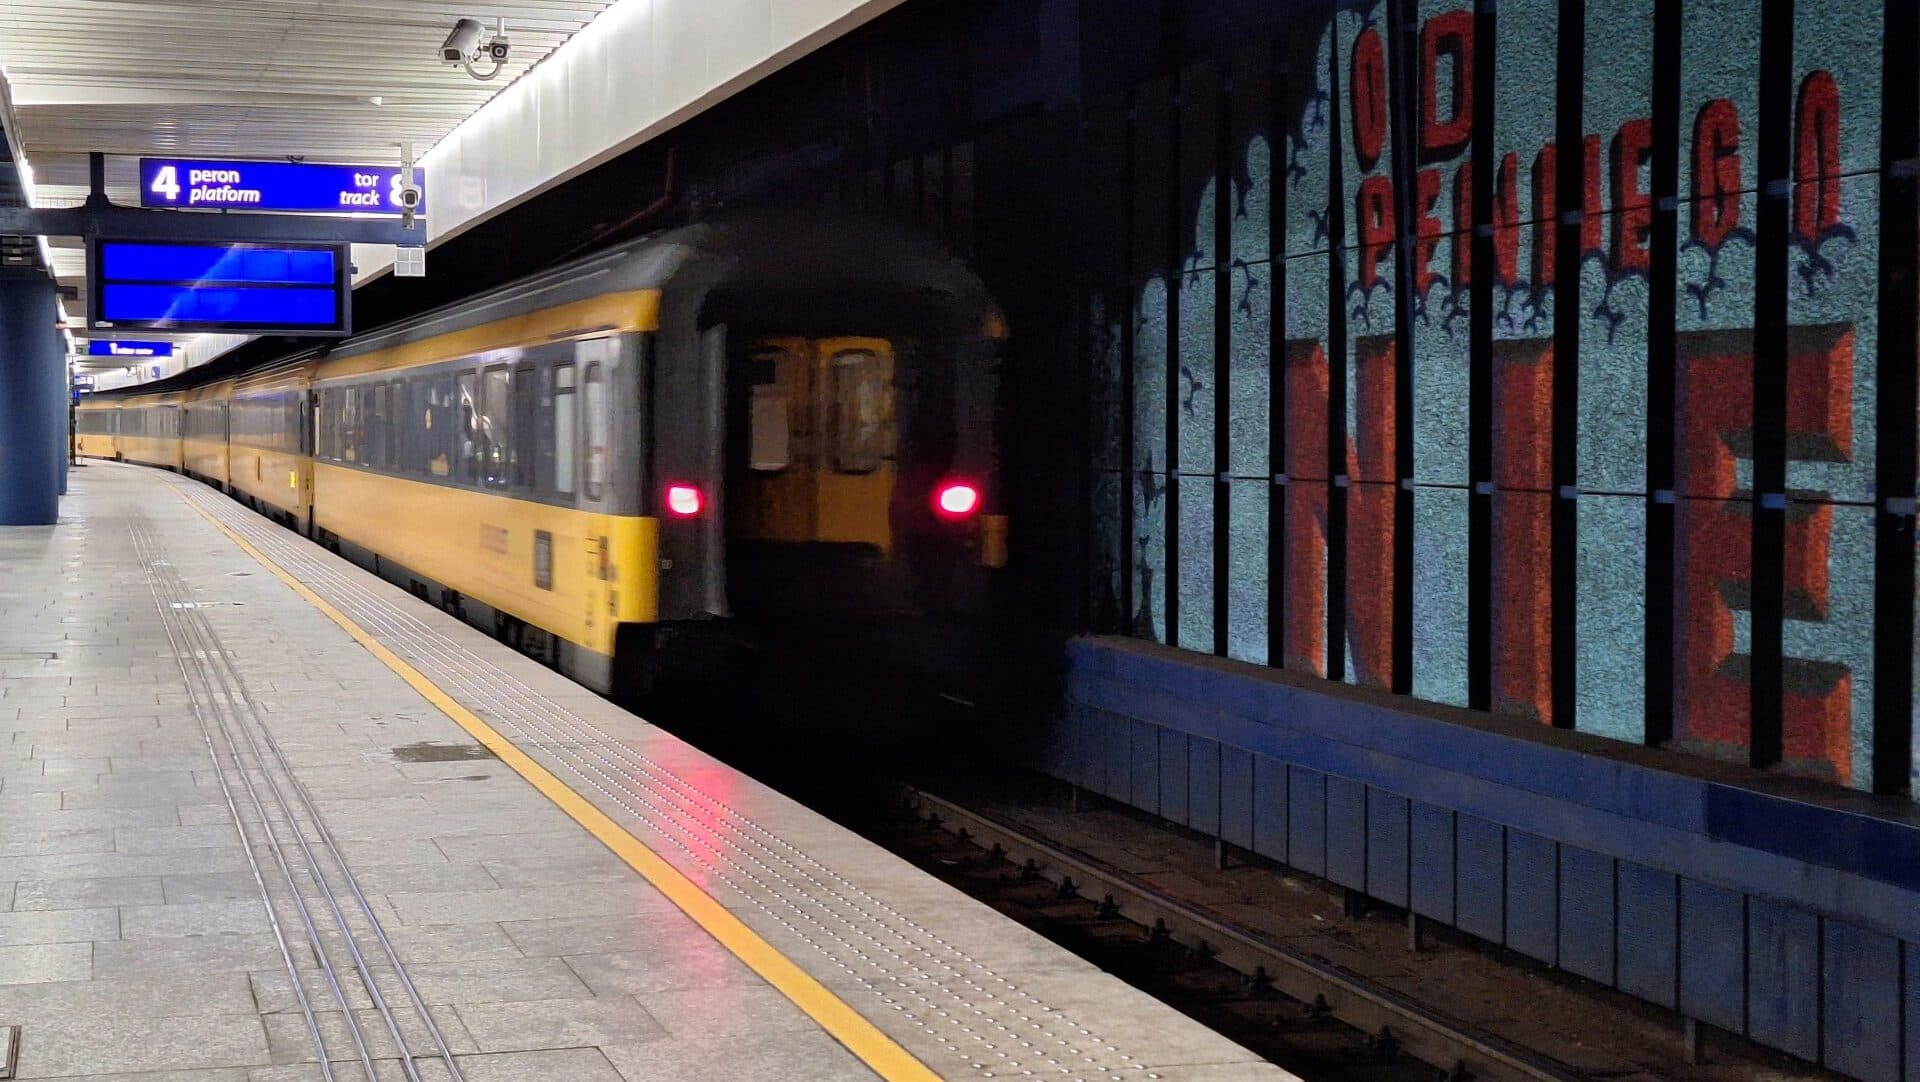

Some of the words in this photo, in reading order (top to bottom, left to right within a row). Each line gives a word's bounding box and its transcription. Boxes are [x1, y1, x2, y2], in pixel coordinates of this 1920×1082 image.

[1351, 10, 1477, 173] OD
[151, 166, 180, 200] 4
[190, 169, 240, 185] peron
[354, 172, 379, 187] tor
[190, 185, 260, 203] platform
[340, 190, 379, 205] track
